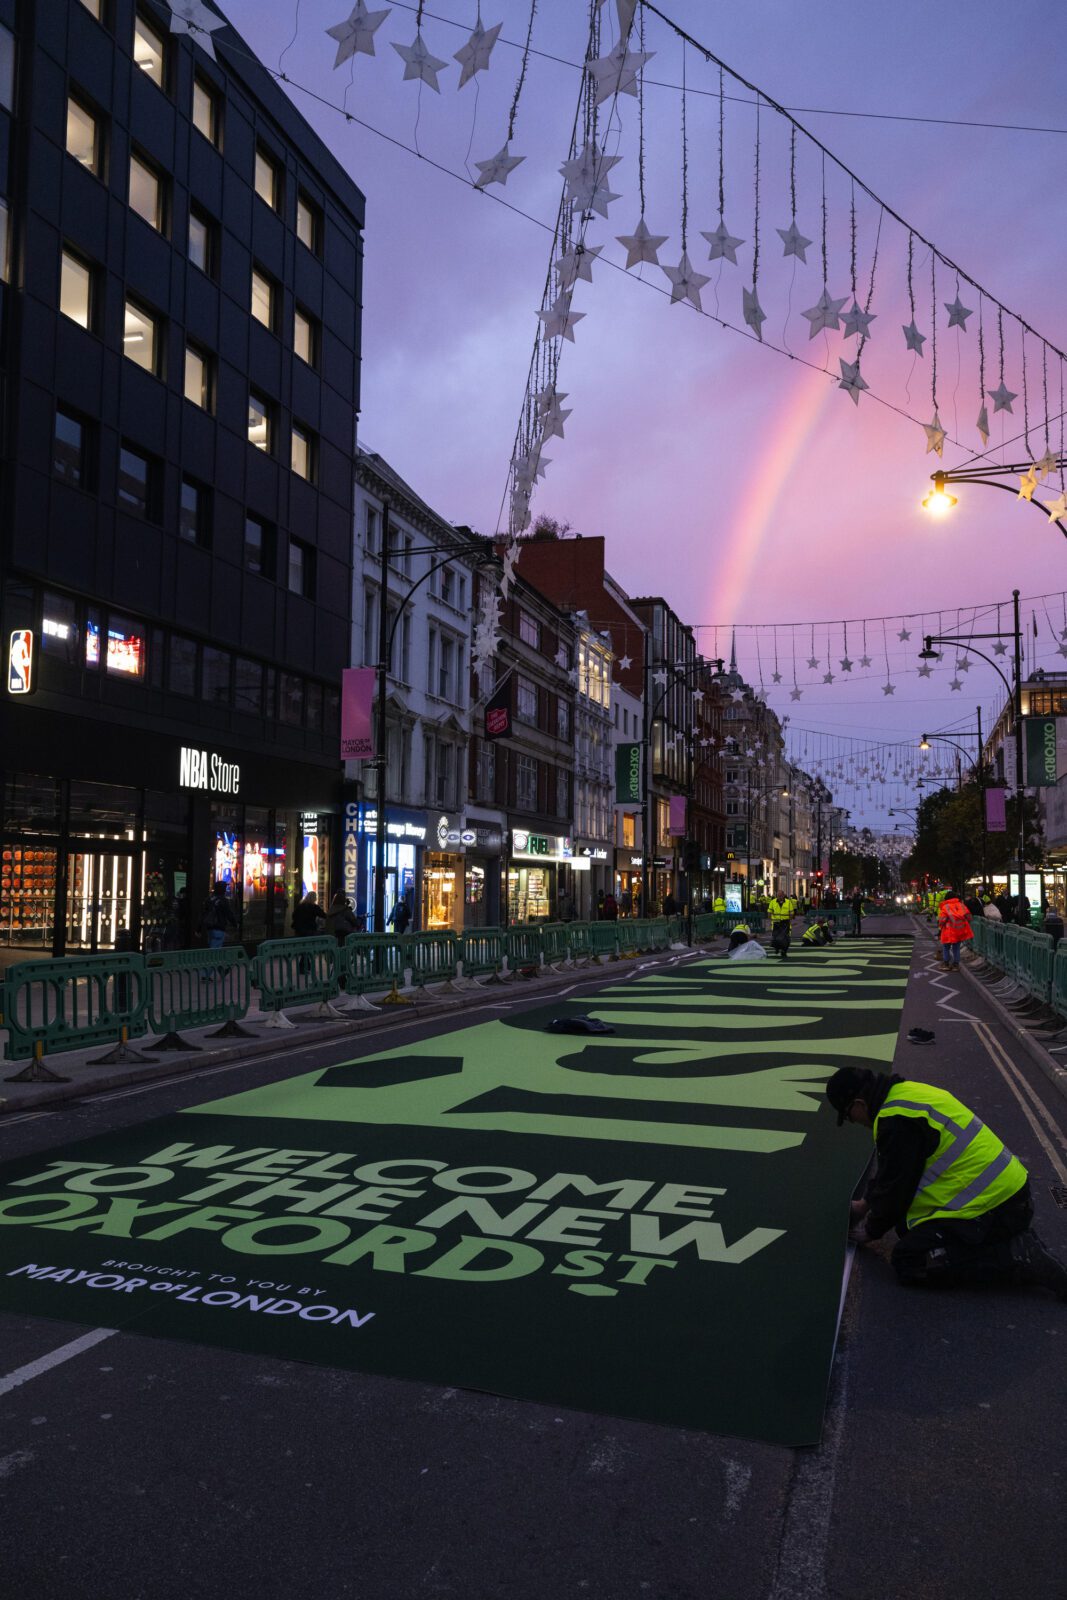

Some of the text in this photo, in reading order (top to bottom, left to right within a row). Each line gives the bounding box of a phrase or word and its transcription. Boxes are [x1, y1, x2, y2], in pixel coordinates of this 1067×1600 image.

[180, 747, 240, 794] NBA Store
[342, 745, 372, 753] LONDON
[630, 747, 640, 792] OXFORD
[1044, 722, 1056, 774] OXFORD
[344, 803, 357, 893] CHANGE
[138, 1142, 728, 1218] WELCOME
[0, 1192, 679, 1290] OXFORD ST
[6, 1161, 789, 1264] TO THE NEW
[6, 1263, 376, 1328] MAYOR OF LONDON
[100, 1259, 327, 1297] BROUGHT TO YOU BY
